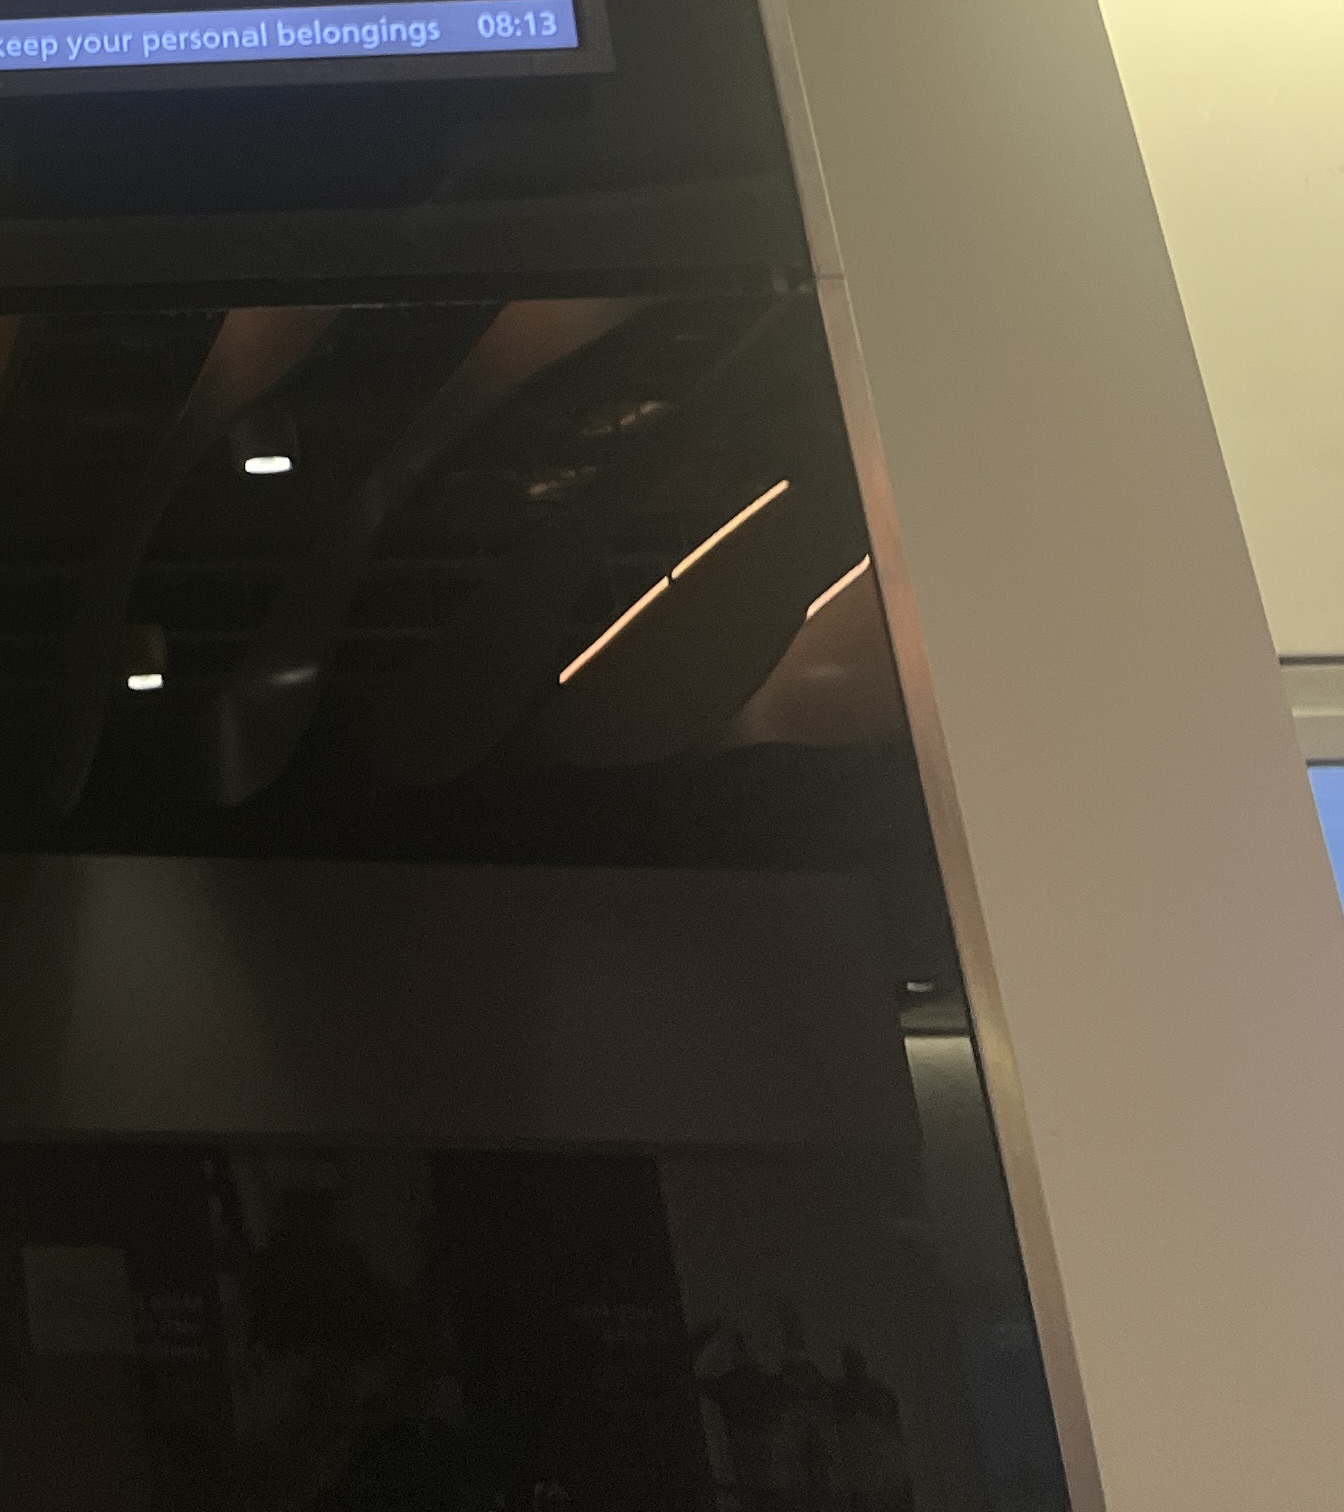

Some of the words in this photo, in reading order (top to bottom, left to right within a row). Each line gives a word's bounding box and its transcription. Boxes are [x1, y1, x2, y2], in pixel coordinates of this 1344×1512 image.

[66, 34, 133, 60] your
[142, 21, 269, 58] personal
[276, 15, 442, 50] belongings
[476, 10, 558, 38] 08:13
